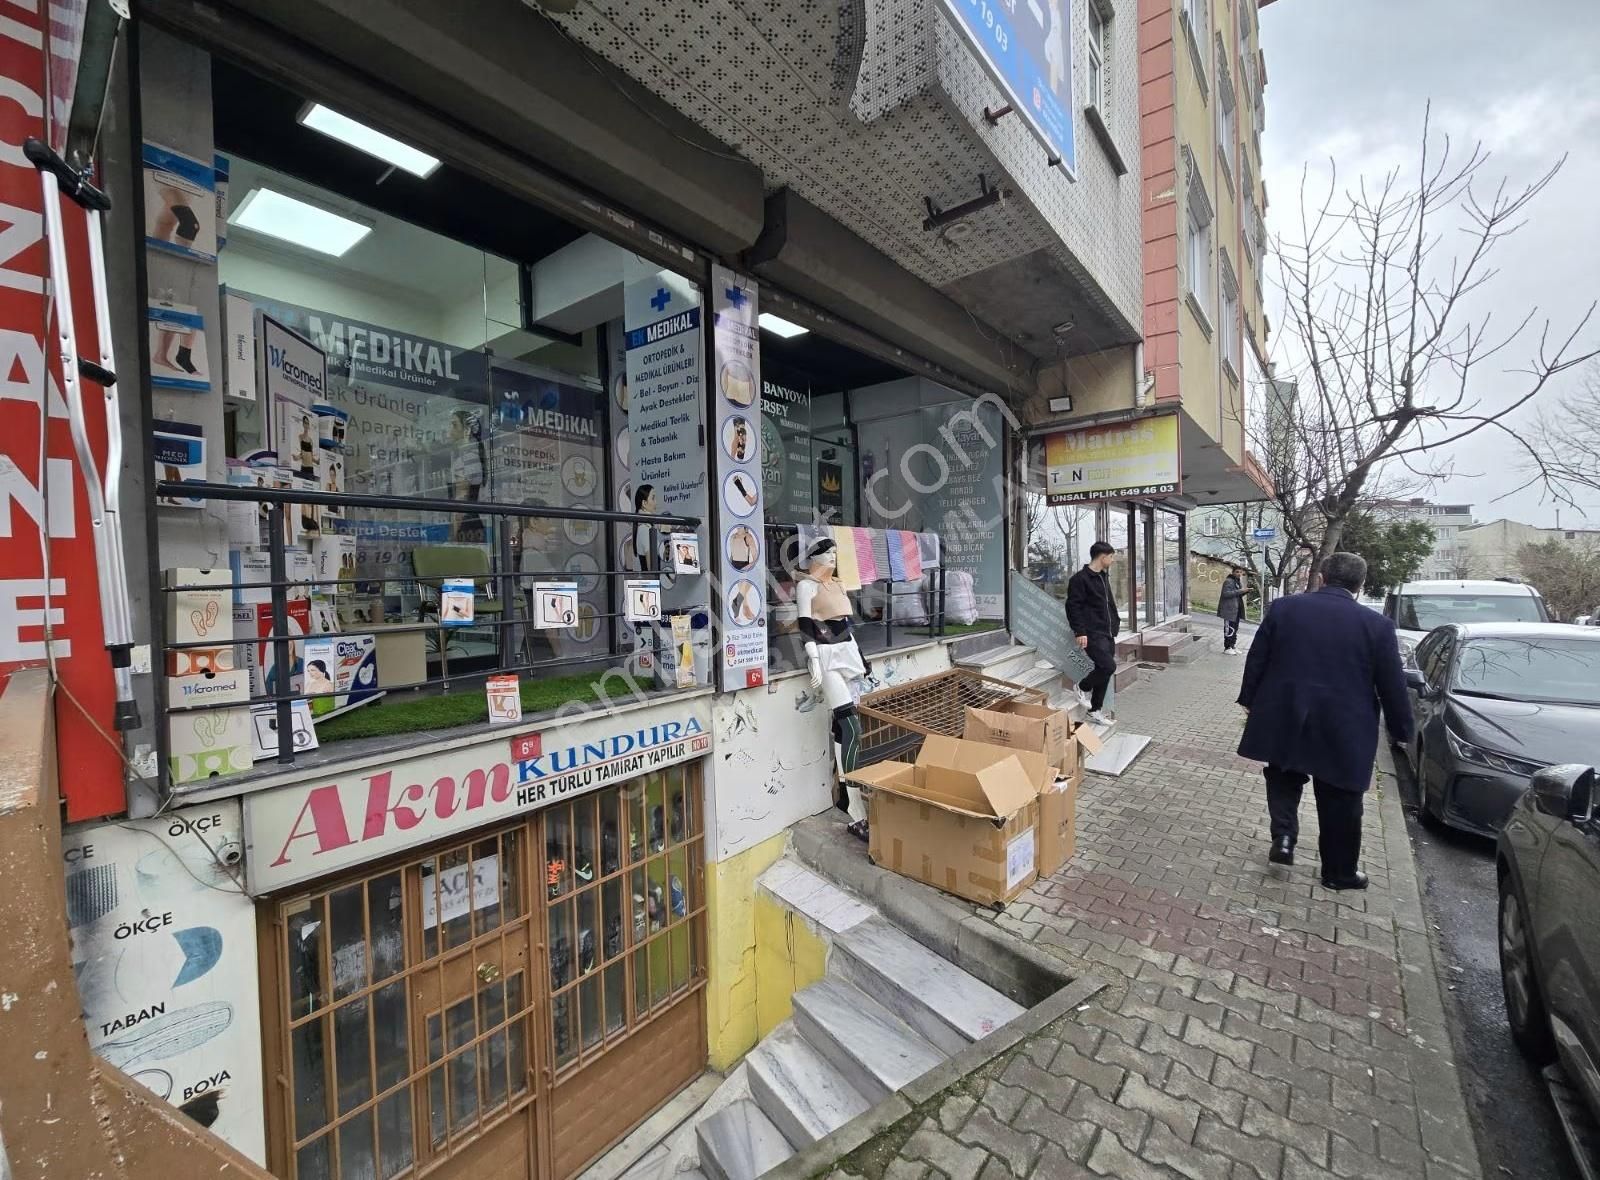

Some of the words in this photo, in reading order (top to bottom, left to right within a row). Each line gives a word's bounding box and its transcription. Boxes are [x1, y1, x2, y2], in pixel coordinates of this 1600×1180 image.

[995, 24, 1008, 53] 03
[1051, 493, 1087, 503] ÜNSAL
[1089, 489, 1118, 499] İPLİK
[1120, 488, 1140, 497] 649
[1142, 486, 1157, 495] 46
[1160, 484, 1175, 493] 03
[516, 783, 546, 807] HER
[549, 768, 592, 797] TÜRLÜ
[595, 754, 644, 782] TAMİRAT
[647, 742, 686, 765] YAPILIR
[269, 761, 515, 868] Akın
[516, 716, 703, 785] KUNDURA
[168, 813, 222, 837] ÖKÇE
[113, 911, 173, 941] ÖKÇE
[99, 1001, 166, 1038] TABAN
[183, 1069, 232, 1101] BOYA
